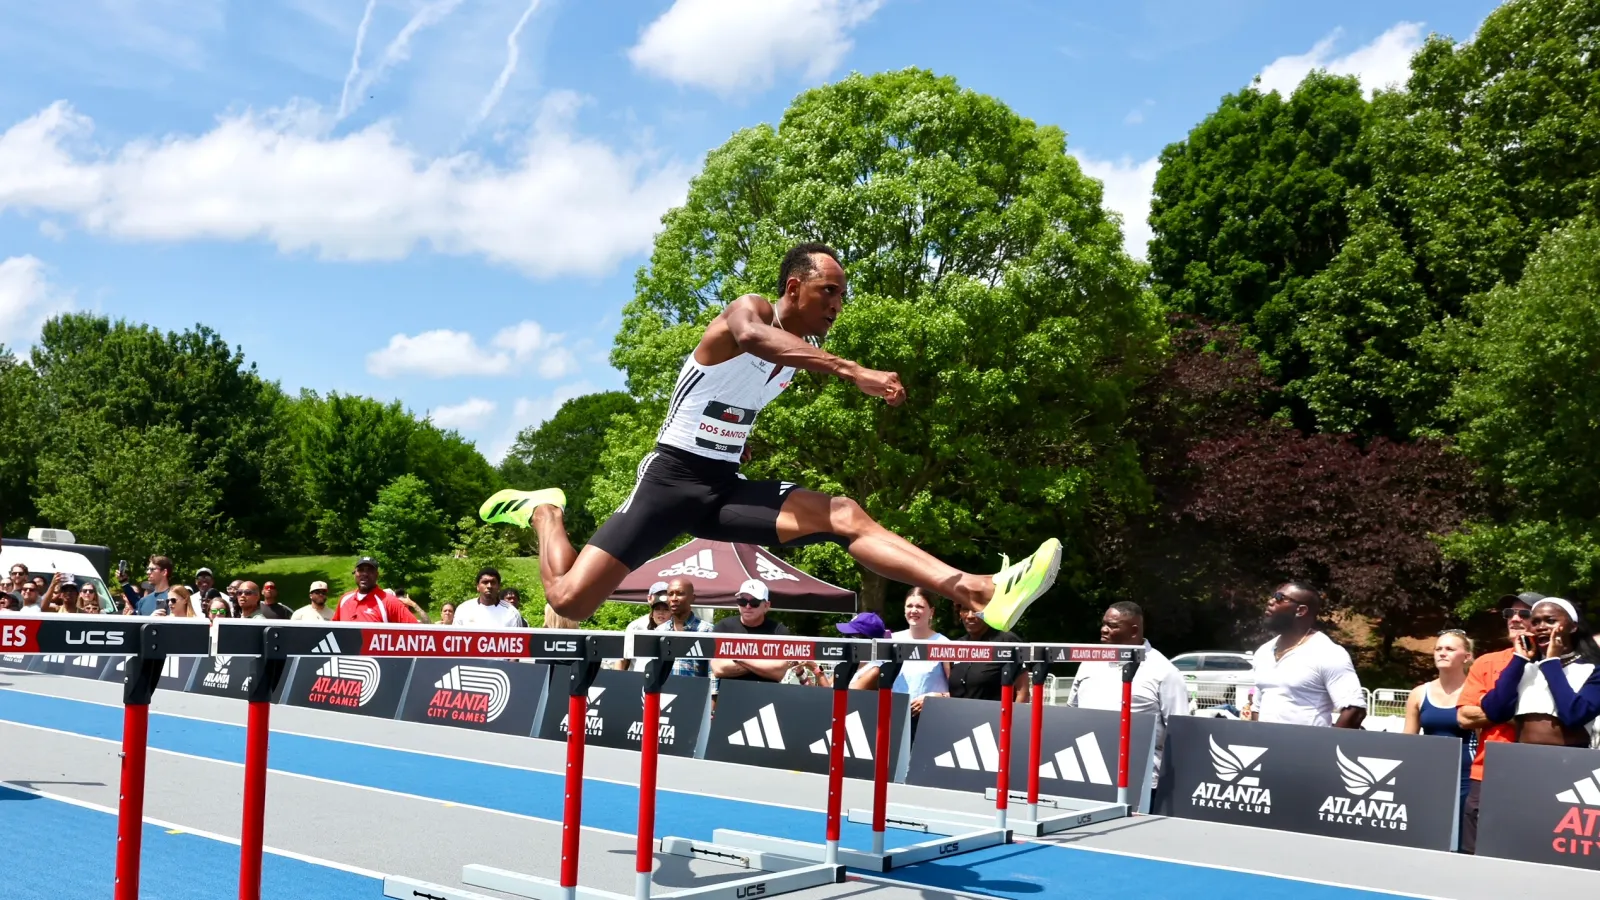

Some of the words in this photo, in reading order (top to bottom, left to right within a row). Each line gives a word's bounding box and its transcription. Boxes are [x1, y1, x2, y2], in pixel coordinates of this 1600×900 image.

[699, 422, 719, 435] DOS
[720, 429, 747, 439] SANTOS
[714, 443, 728, 451] 2025
[658, 564, 719, 579] adidas
[65, 630, 125, 645] UCS
[368, 633, 436, 652] ATLANTA
[442, 635, 473, 653] CITY
[477, 636, 524, 654] GAMES
[544, 640, 577, 652] UCS
[719, 641, 759, 656] ATLANTA
[762, 643, 781, 657] CITY
[782, 644, 811, 657] GAMES
[822, 647, 844, 656] UCS
[929, 647, 956, 658] ATLANTA
[957, 647, 970, 659] CITY
[970, 648, 990, 659] GAMES
[997, 650, 1012, 658] UCS
[1071, 649, 1091, 659] ATLANTA
[1091, 649, 1101, 659] CITY
[1101, 650, 1116, 660] GAMES
[1120, 651, 1132, 659] UCS
[203, 672, 230, 684] ATLANTA
[311, 676, 362, 698] ATLANTA
[308, 693, 327, 703] CITY
[329, 695, 359, 707] GAMES
[429, 689, 489, 712] ATLANTA
[427, 707, 449, 718] CITY
[451, 709, 486, 723] GAMES
[626, 733, 641, 741] TRA
[658, 737, 674, 745] LUB
[1191, 782, 1272, 806] ATLANTA
[1191, 797, 1232, 810] TRACK
[1238, 803, 1271, 815] CLUB
[1318, 795, 1408, 822] ATLANTA
[1076, 813, 1092, 825] UCS
[1318, 812, 1363, 826] TRACK
[1370, 819, 1408, 831] CLUB
[1552, 806, 1600, 837] AT
[939, 841, 959, 855] UCS
[736, 883, 766, 899] UCS
